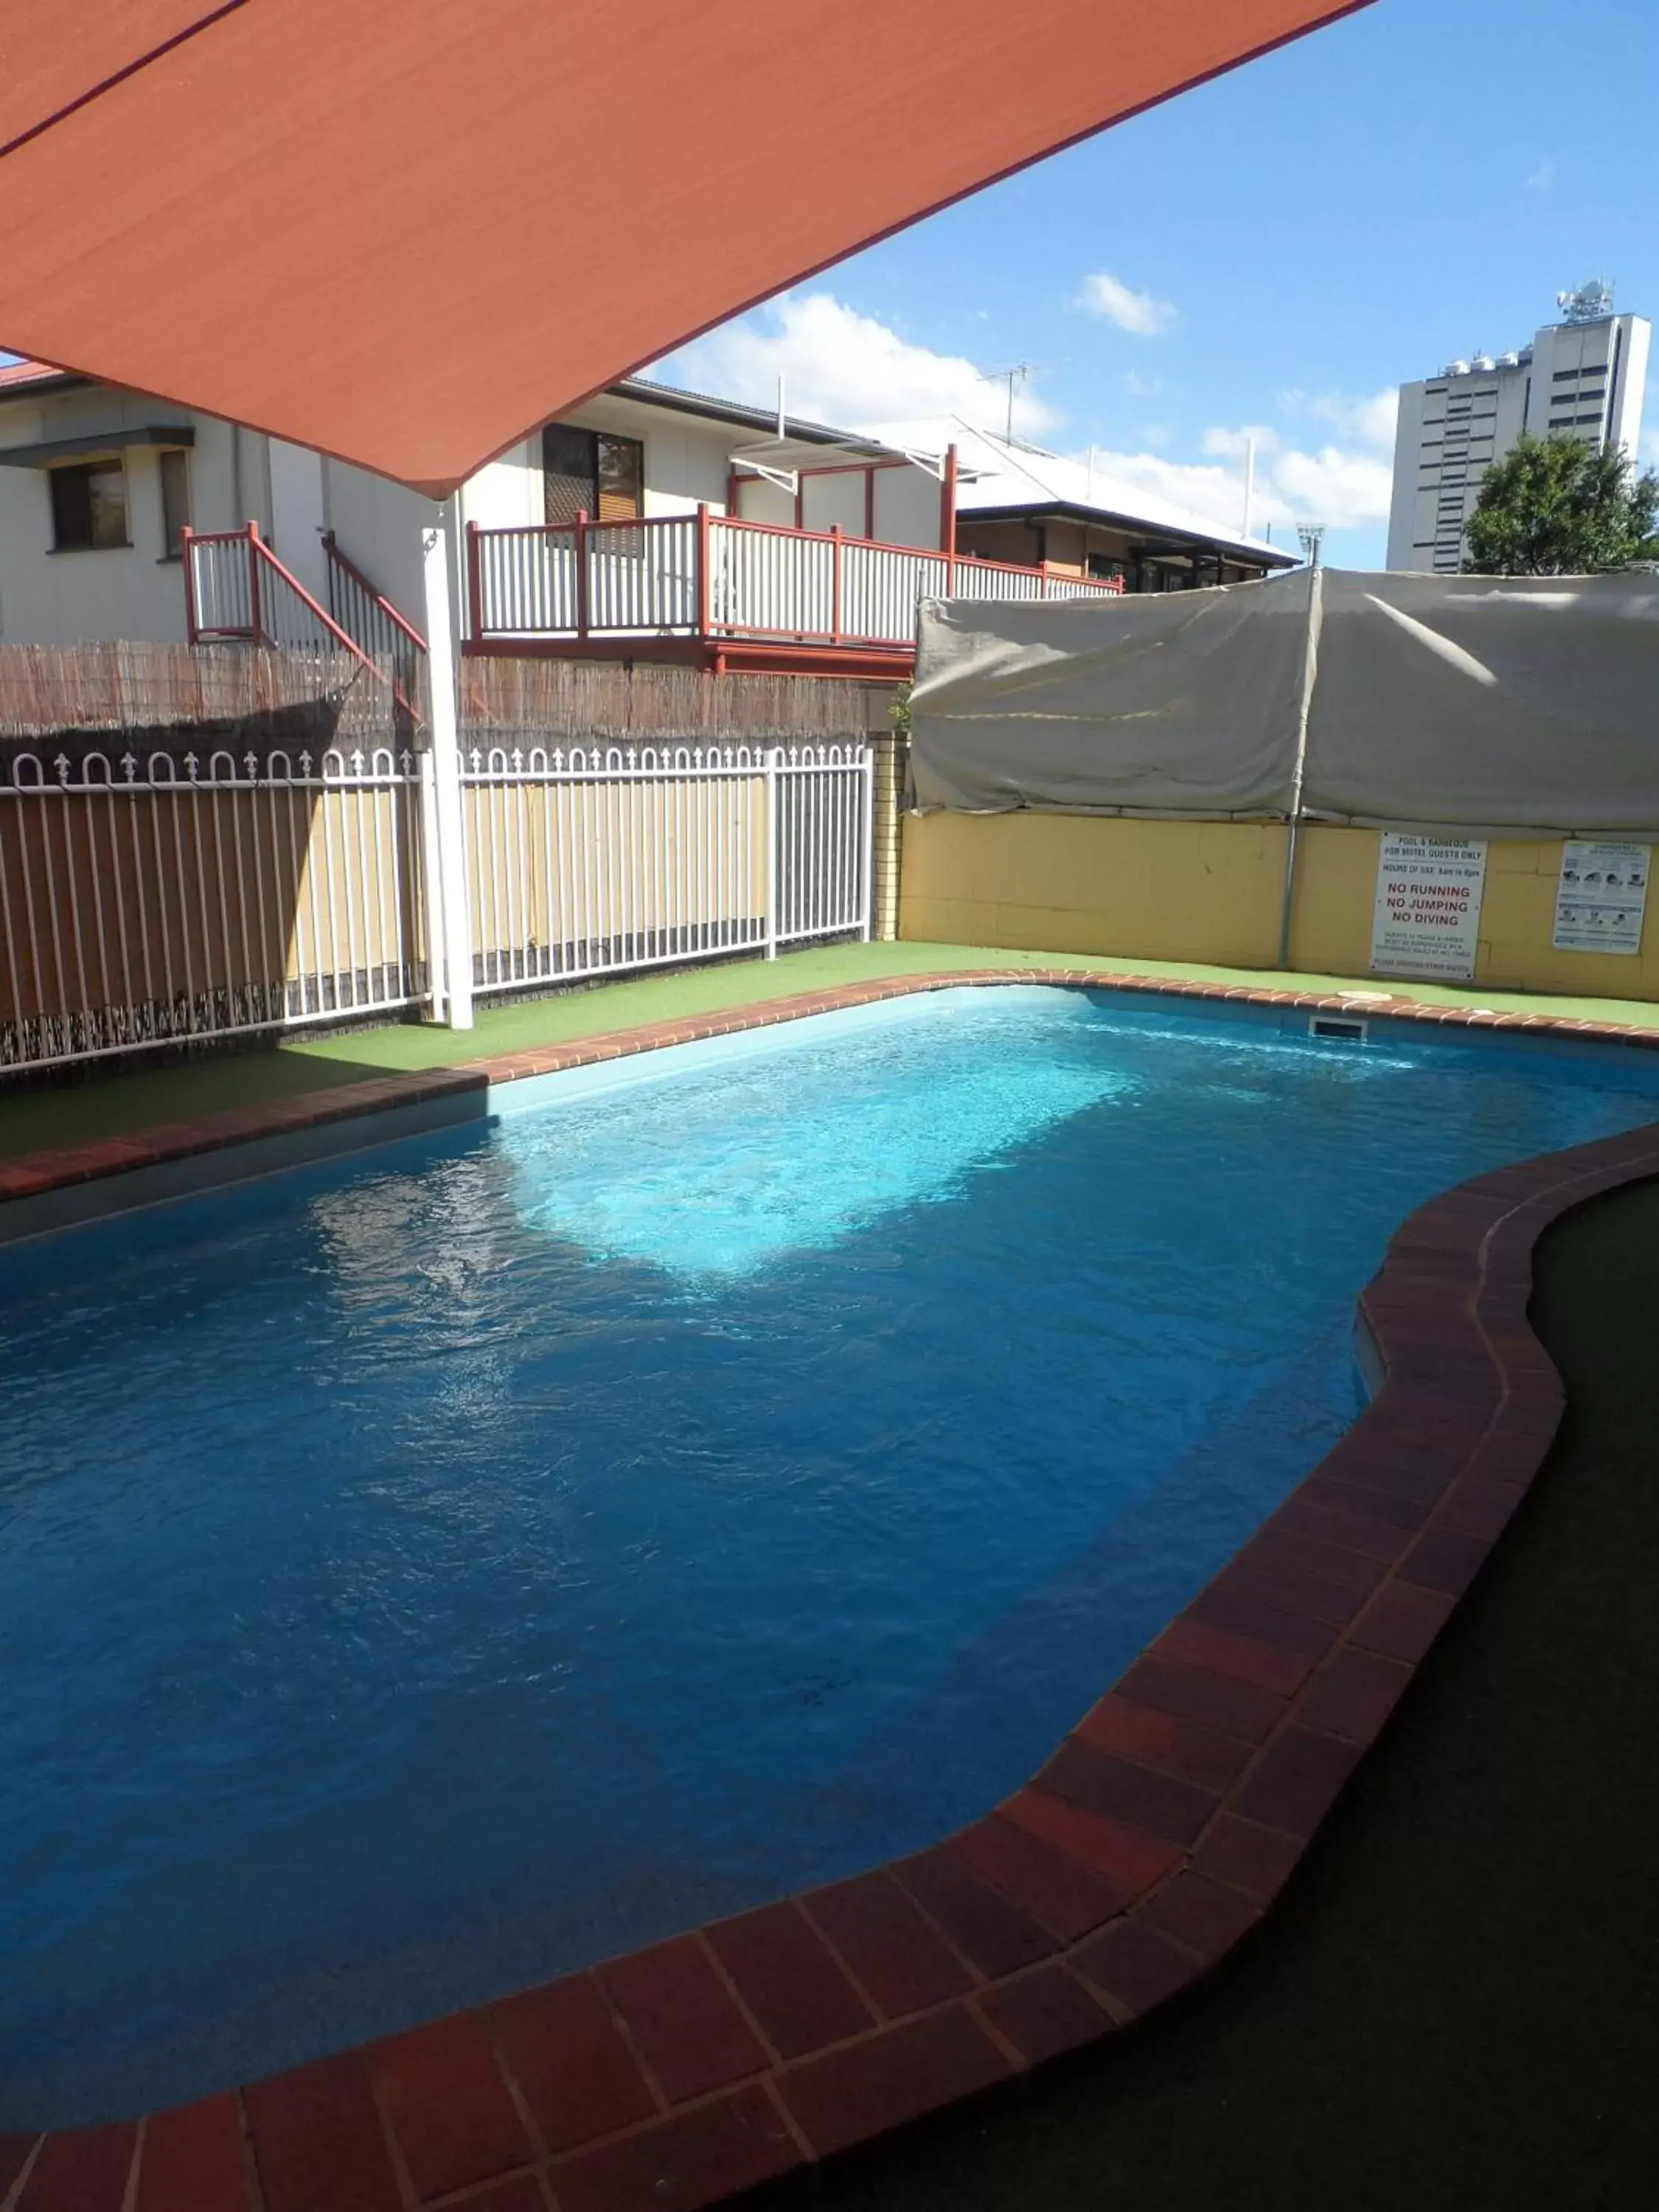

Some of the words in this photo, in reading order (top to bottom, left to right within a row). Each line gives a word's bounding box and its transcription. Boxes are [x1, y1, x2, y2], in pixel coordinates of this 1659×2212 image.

[1399, 837, 1417, 845] POOL
[1385, 847, 1400, 855] FOR
[1402, 848, 1426, 858] MOTEL
[1428, 850, 1459, 860] GUESTS
[1461, 851, 1481, 860] ONLY
[1388, 883, 1407, 893] NO
[1410, 884, 1470, 897] RUNNING
[1387, 897, 1405, 908] NO
[1409, 900, 1468, 912] JUMPING
[1392, 912, 1411, 922] NO
[1415, 914, 1459, 925] DIVING
